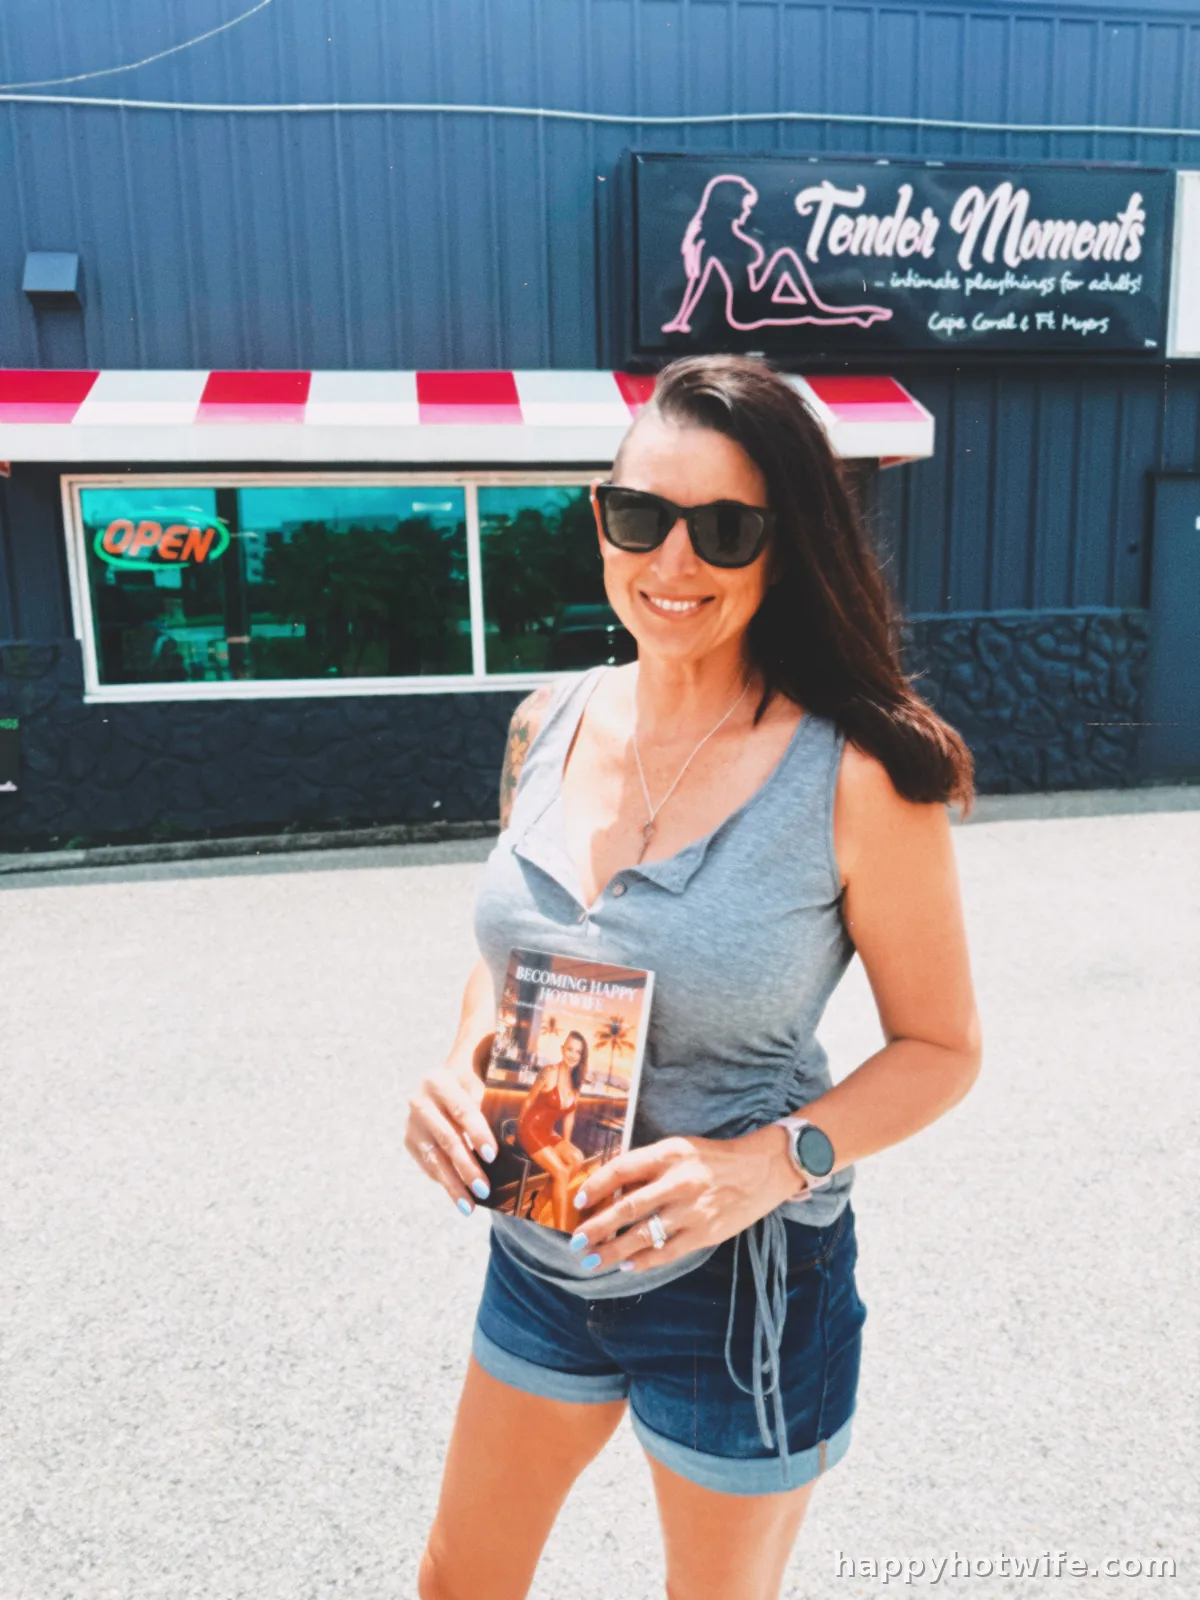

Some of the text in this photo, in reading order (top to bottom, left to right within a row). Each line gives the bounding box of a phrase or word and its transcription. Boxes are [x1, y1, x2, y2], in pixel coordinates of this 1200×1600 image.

[795, 180, 1146, 271] Tender Moments
[890, 268, 960, 290] intimate
[965, 271, 1055, 296] playthings
[1059, 271, 1083, 294] for
[1088, 274, 1143, 295] adults!
[928, 311, 966, 335] Cape
[972, 312, 1016, 331] Coral
[1061, 313, 1109, 335] Myers
[103, 519, 215, 563] OPEN
[515, 965, 637, 1003] BECOMING HAPPY
